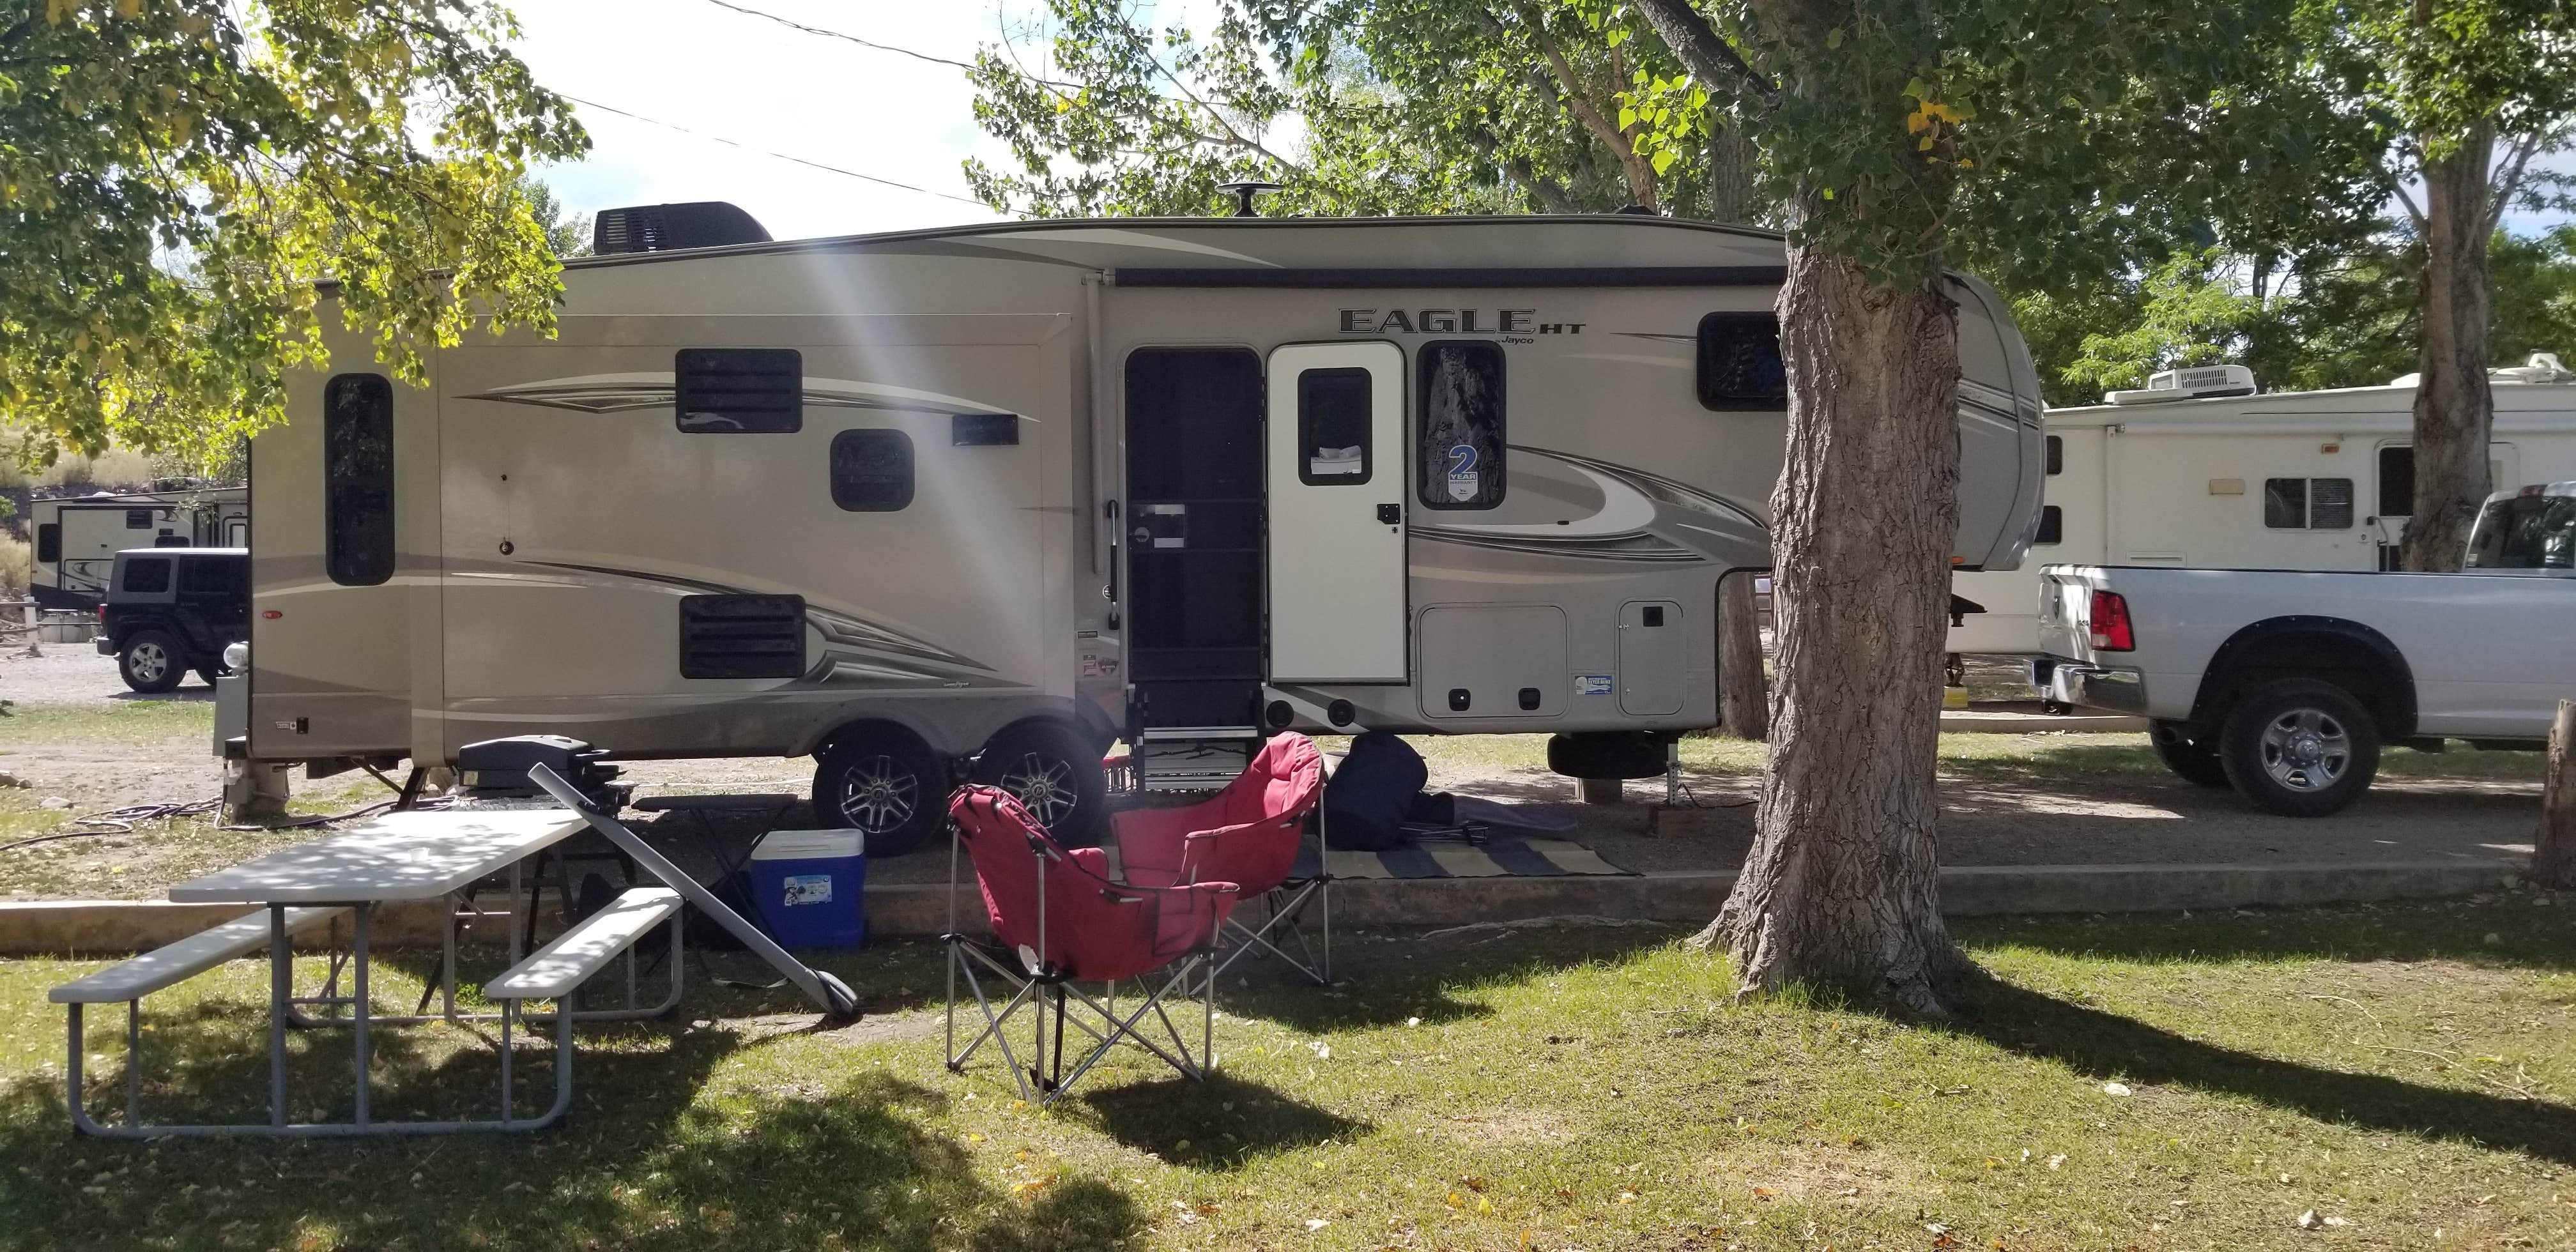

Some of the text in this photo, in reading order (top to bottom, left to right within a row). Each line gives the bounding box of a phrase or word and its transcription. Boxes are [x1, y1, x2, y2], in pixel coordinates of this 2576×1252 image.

[1338, 309, 1586, 334] EAGLE HT
[1501, 335, 1533, 345] Jayco
[1448, 445, 1478, 474] 2
